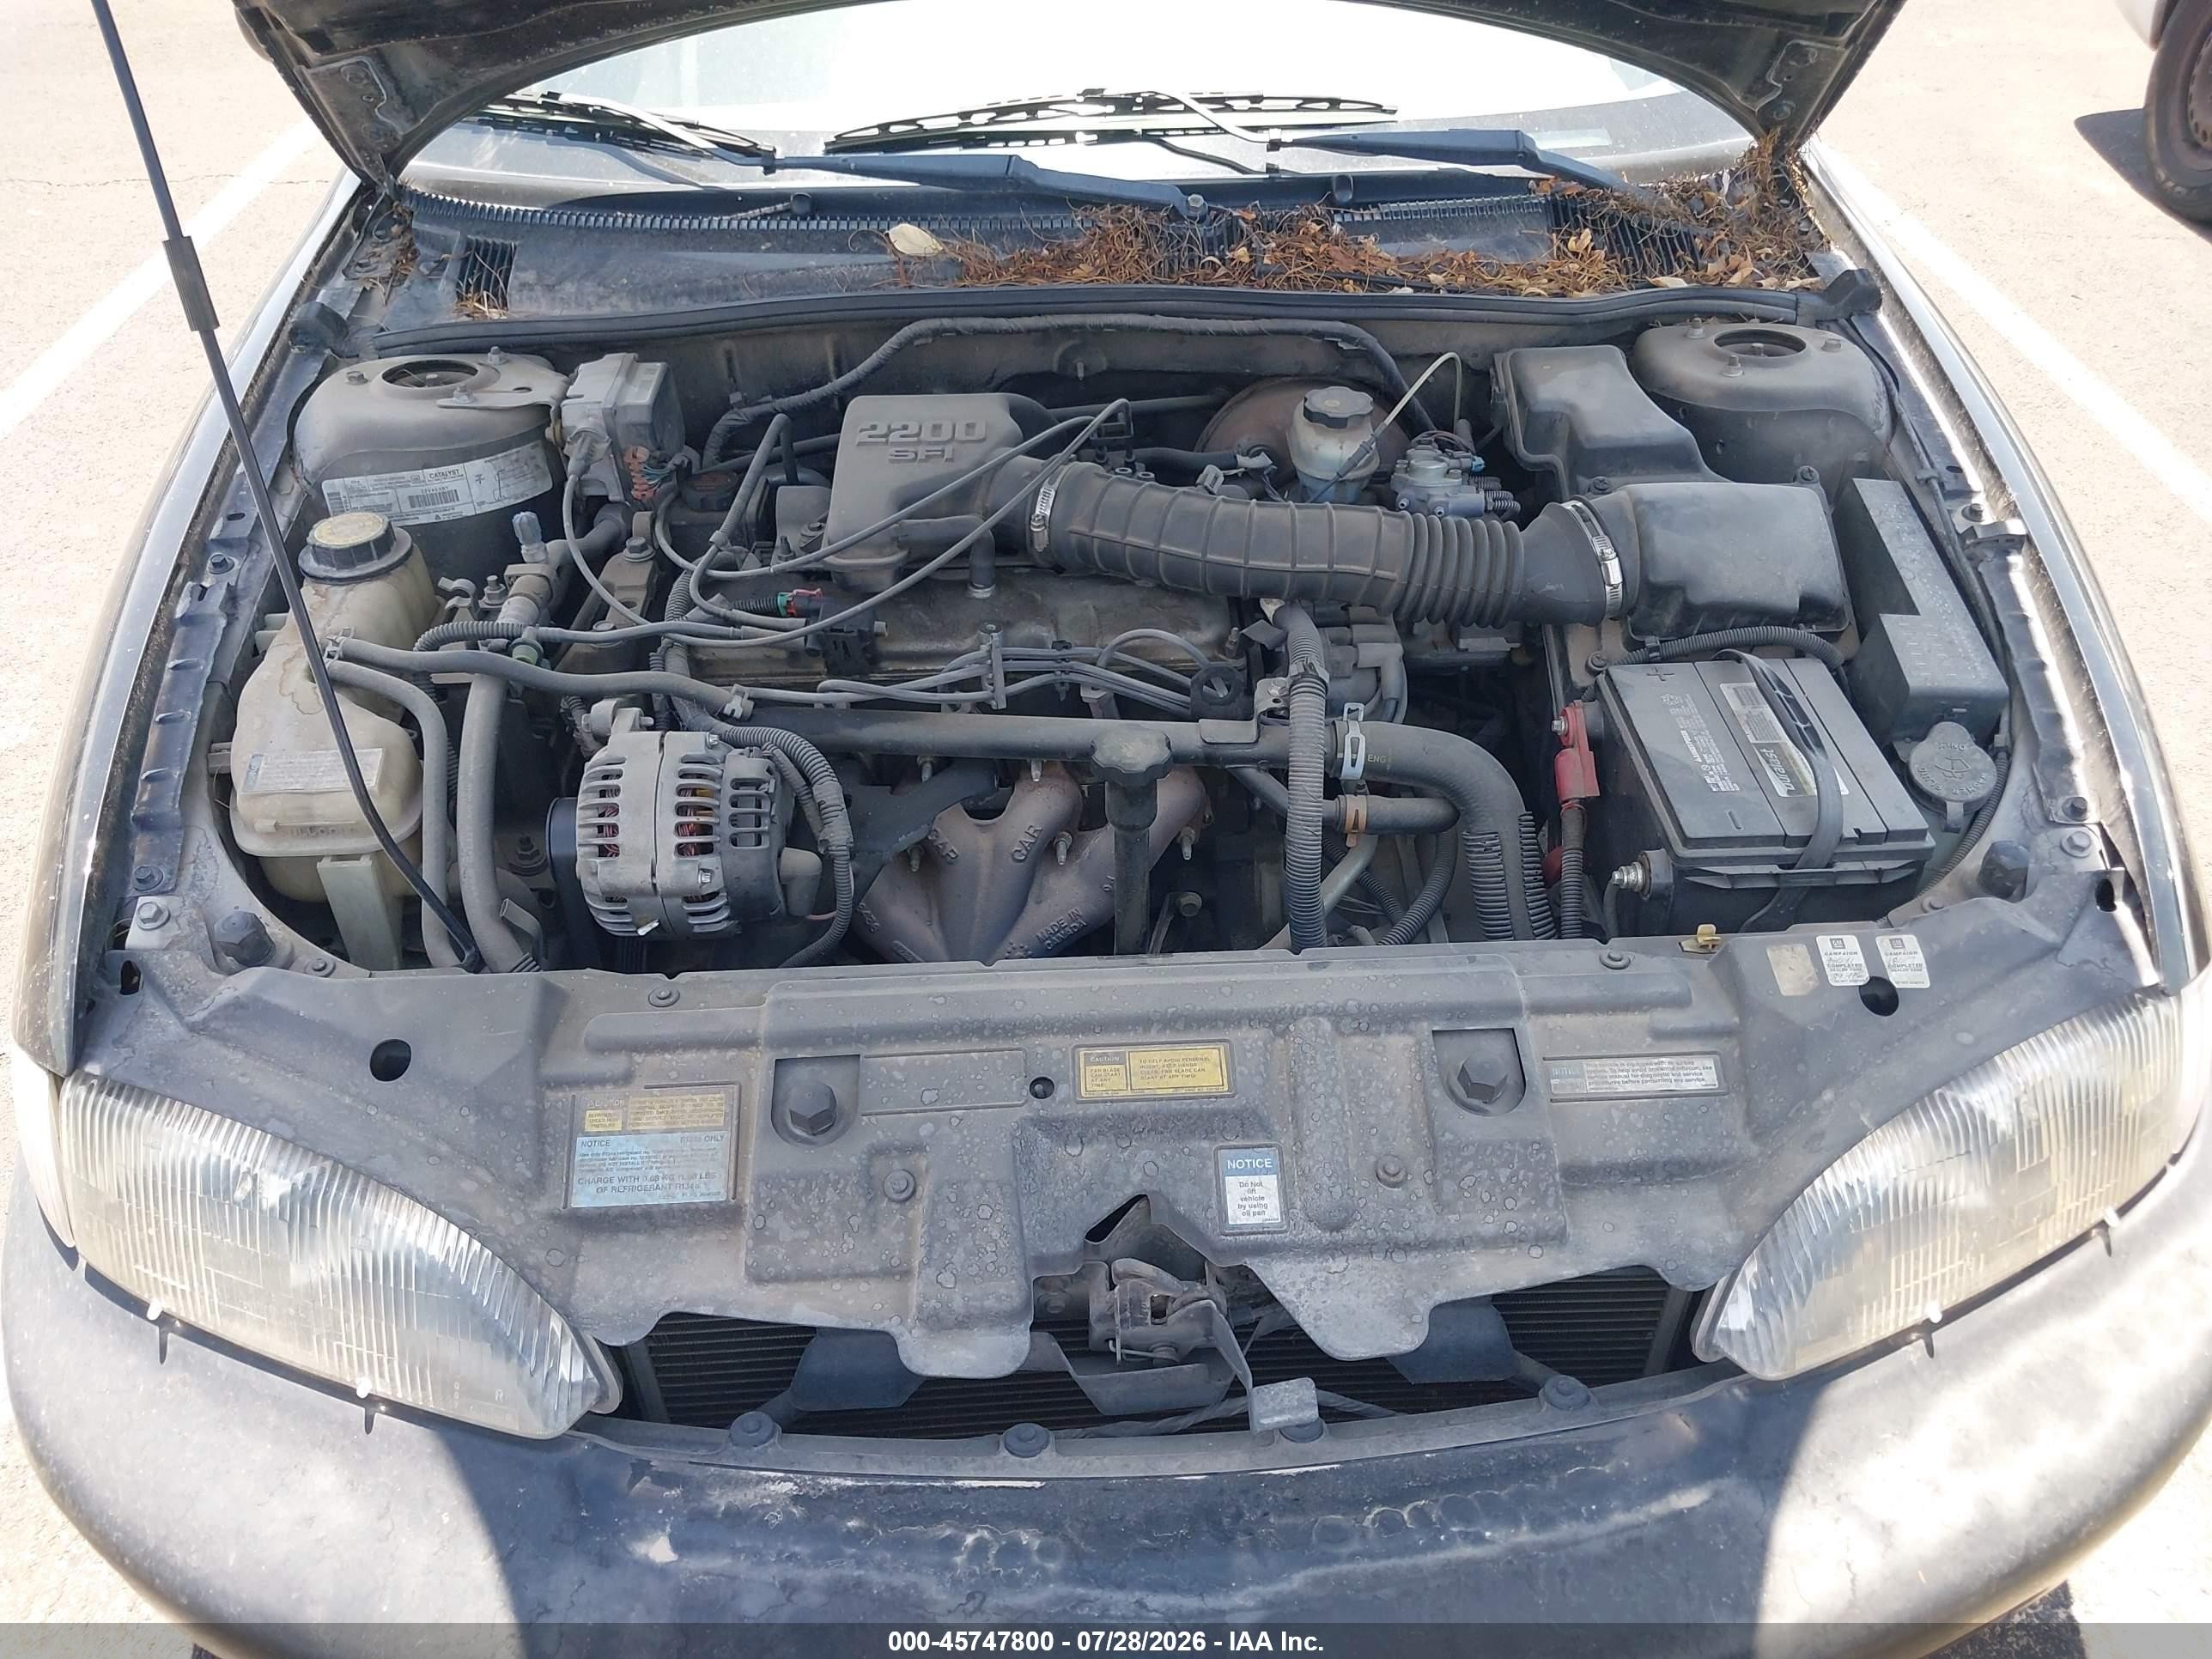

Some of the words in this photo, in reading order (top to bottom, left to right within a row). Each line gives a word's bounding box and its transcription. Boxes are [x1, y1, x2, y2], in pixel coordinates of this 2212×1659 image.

[856, 422, 988, 447] 2200
[887, 446, 955, 464] SFI
[428, 468, 460, 479] CATALYST
[1367, 754, 1387, 763] ENG
[1012, 824, 1043, 861] CAR
[1036, 918, 1066, 942] MADE
[1067, 906, 1084, 921] IN
[1045, 920, 1088, 950] CANADA
[1226, 1158, 1273, 1170] NOTICE
[577, 1176, 615, 1185] CHARGE
[617, 1175, 640, 1183] WITH
[611, 1183, 672, 1193] REFRIGERANT
